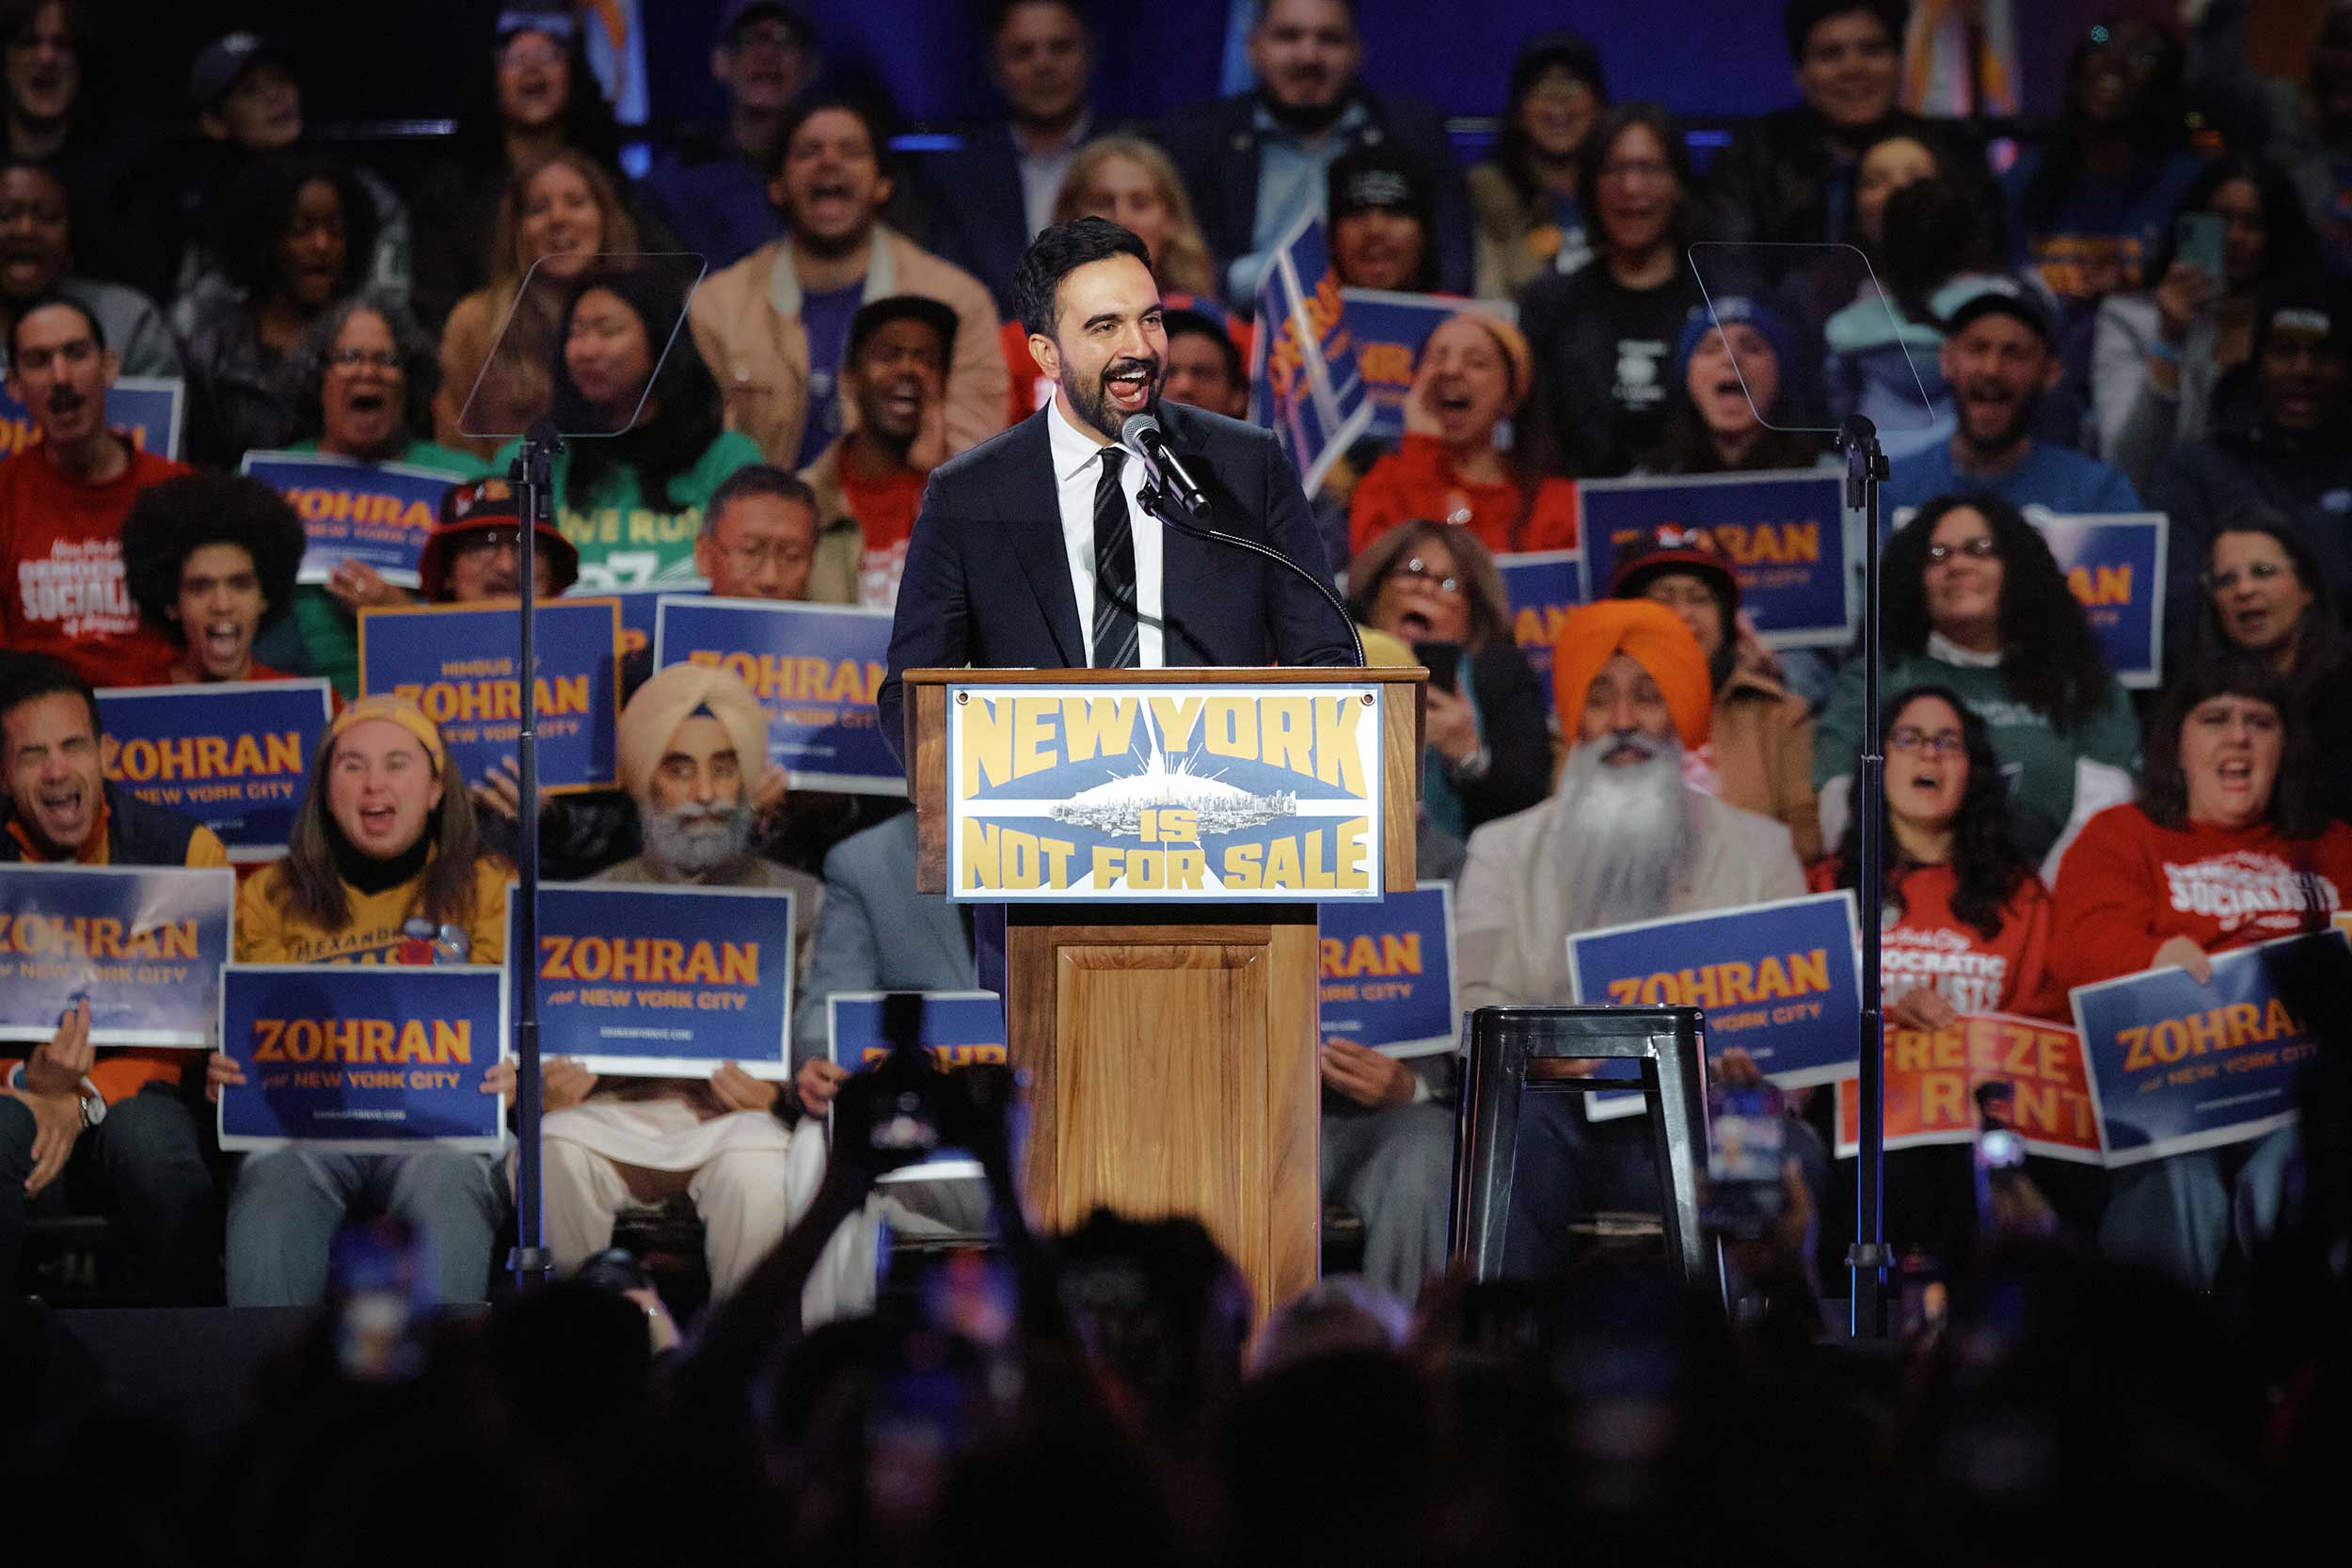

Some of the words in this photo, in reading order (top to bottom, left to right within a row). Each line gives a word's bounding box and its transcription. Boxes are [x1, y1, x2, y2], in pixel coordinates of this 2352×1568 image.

[286, 487, 433, 530] OHRA
[961, 696, 1138, 800] NEW
[1149, 696, 1369, 800] YORK
[247, 782, 294, 799] CITY
[1139, 809, 1198, 843] IS
[962, 816, 1074, 890] NOT
[1092, 845, 1205, 890] FOR
[1224, 816, 1369, 890] SALE
[139, 966, 186, 985] CITY
[539, 935, 759, 986] ZOHRAN
[1319, 932, 1422, 978] RAN
[1881, 949, 2007, 979] OCRATIC
[580, 989, 632, 1007] NEW
[636, 990, 694, 1009] YORK
[697, 992, 747, 1010] CITY
[251, 1019, 472, 1065] ZOHRAN
[2116, 997, 2300, 1072] ZOHRA
[294, 1070, 343, 1087] NEW
[348, 1071, 405, 1089] YORK
[409, 1070, 460, 1090] CITY
